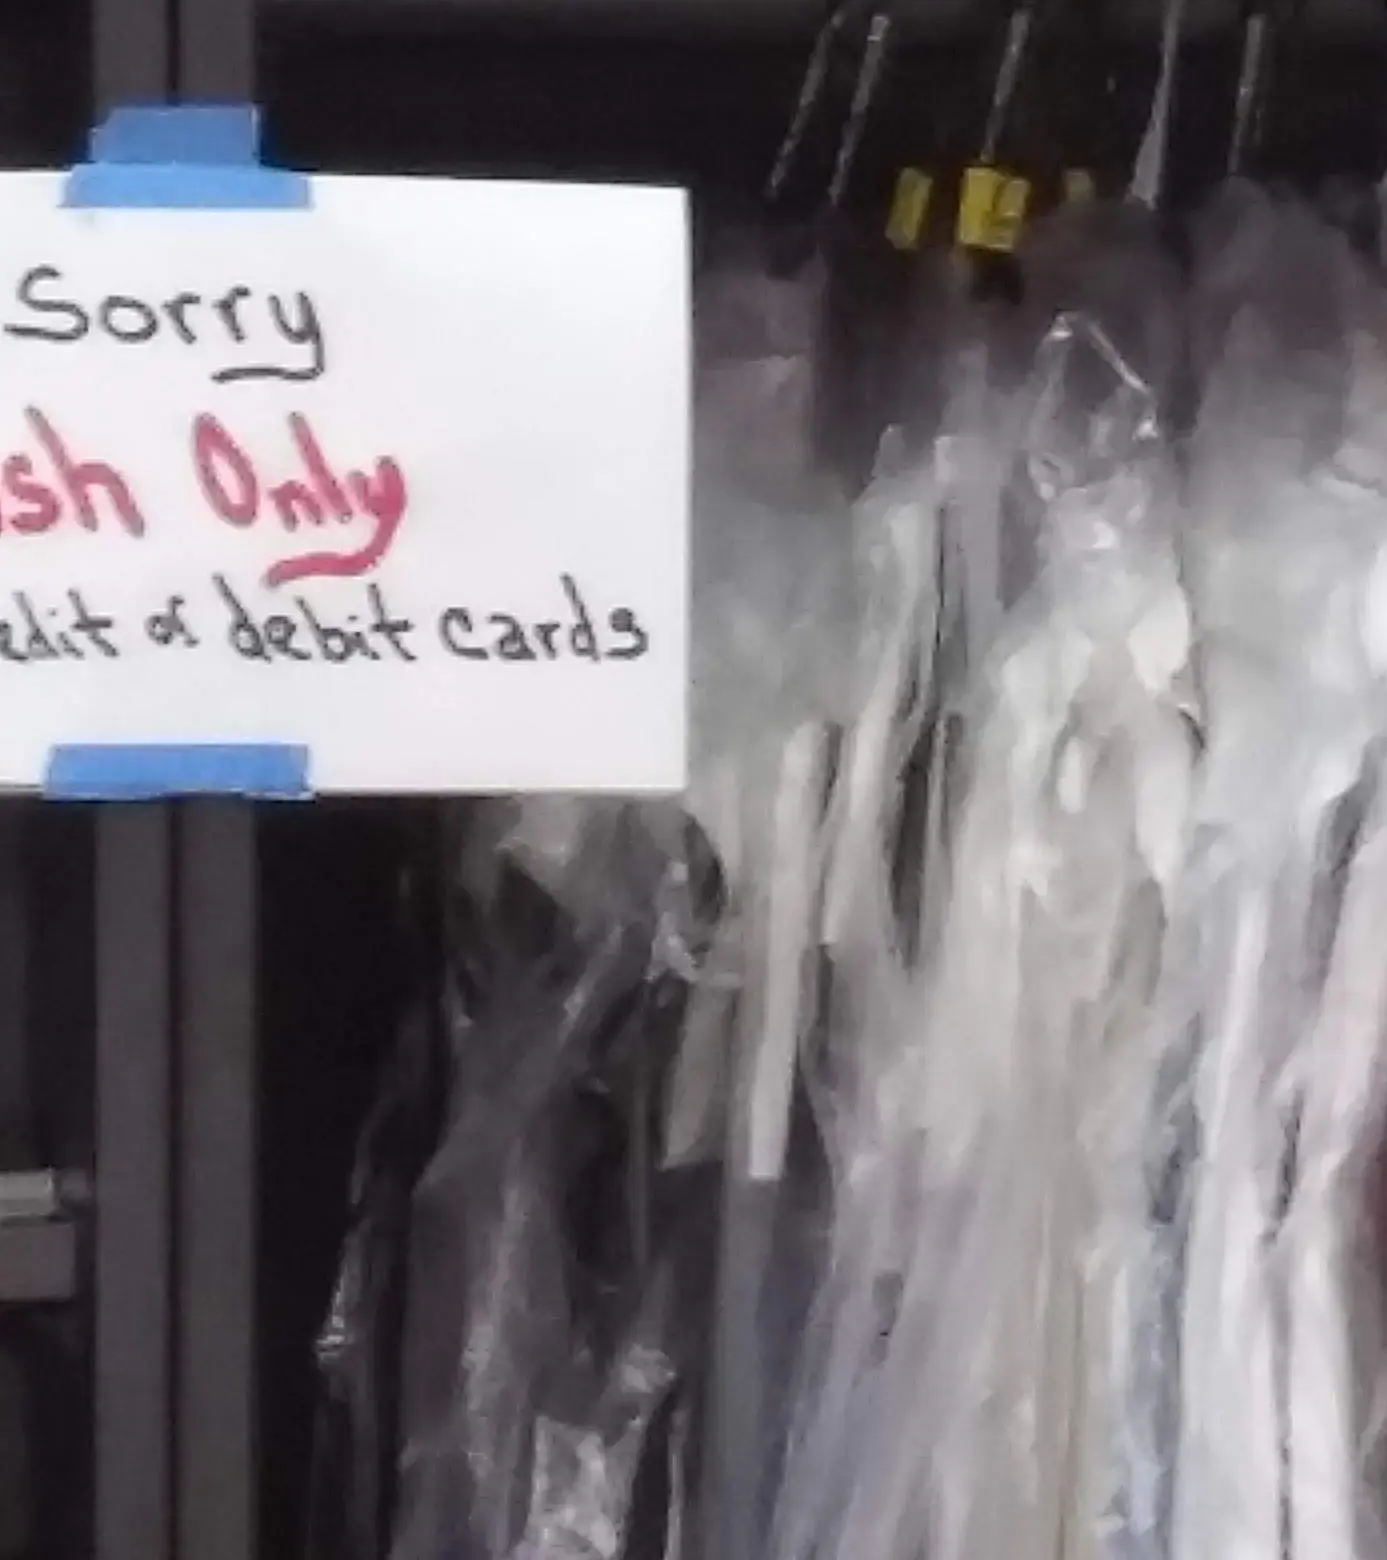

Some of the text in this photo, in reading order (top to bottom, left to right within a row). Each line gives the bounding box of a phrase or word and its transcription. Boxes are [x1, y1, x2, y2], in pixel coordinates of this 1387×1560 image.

[3, 266, 325, 383] Sorry
[192, 411, 407, 589] Only
[211, 572, 417, 662] debit
[438, 573, 650, 661] cards
